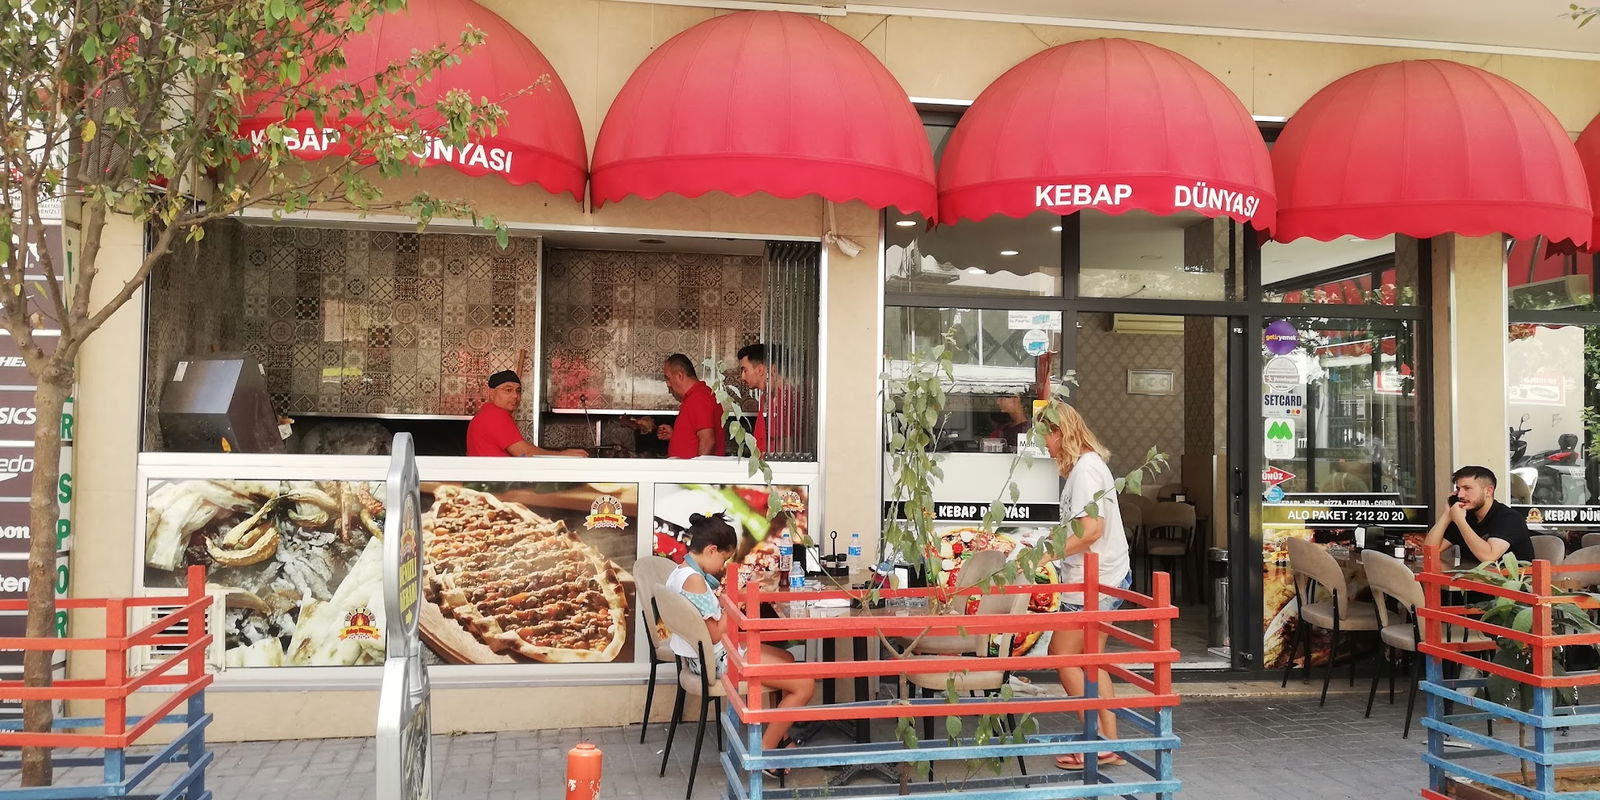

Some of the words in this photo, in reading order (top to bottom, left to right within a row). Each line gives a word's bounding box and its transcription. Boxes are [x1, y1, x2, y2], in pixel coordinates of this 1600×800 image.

[251, 127, 341, 153] KBAP
[393, 129, 512, 173] ÜNYASI
[1035, 184, 1132, 206] KEBAP
[1174, 181, 1260, 218] DÜNYASI
[1264, 395, 1302, 407] SETCARD
[938, 505, 977, 518] KEBAP
[980, 504, 1030, 519] DYASI
[1287, 511, 1309, 520] ALO
[1312, 511, 1347, 521] PAKET
[1355, 511, 1374, 521] 212
[1376, 511, 1389, 521] 20
[1391, 512, 1404, 521] 20
[1544, 510, 1578, 521] KEBAP
